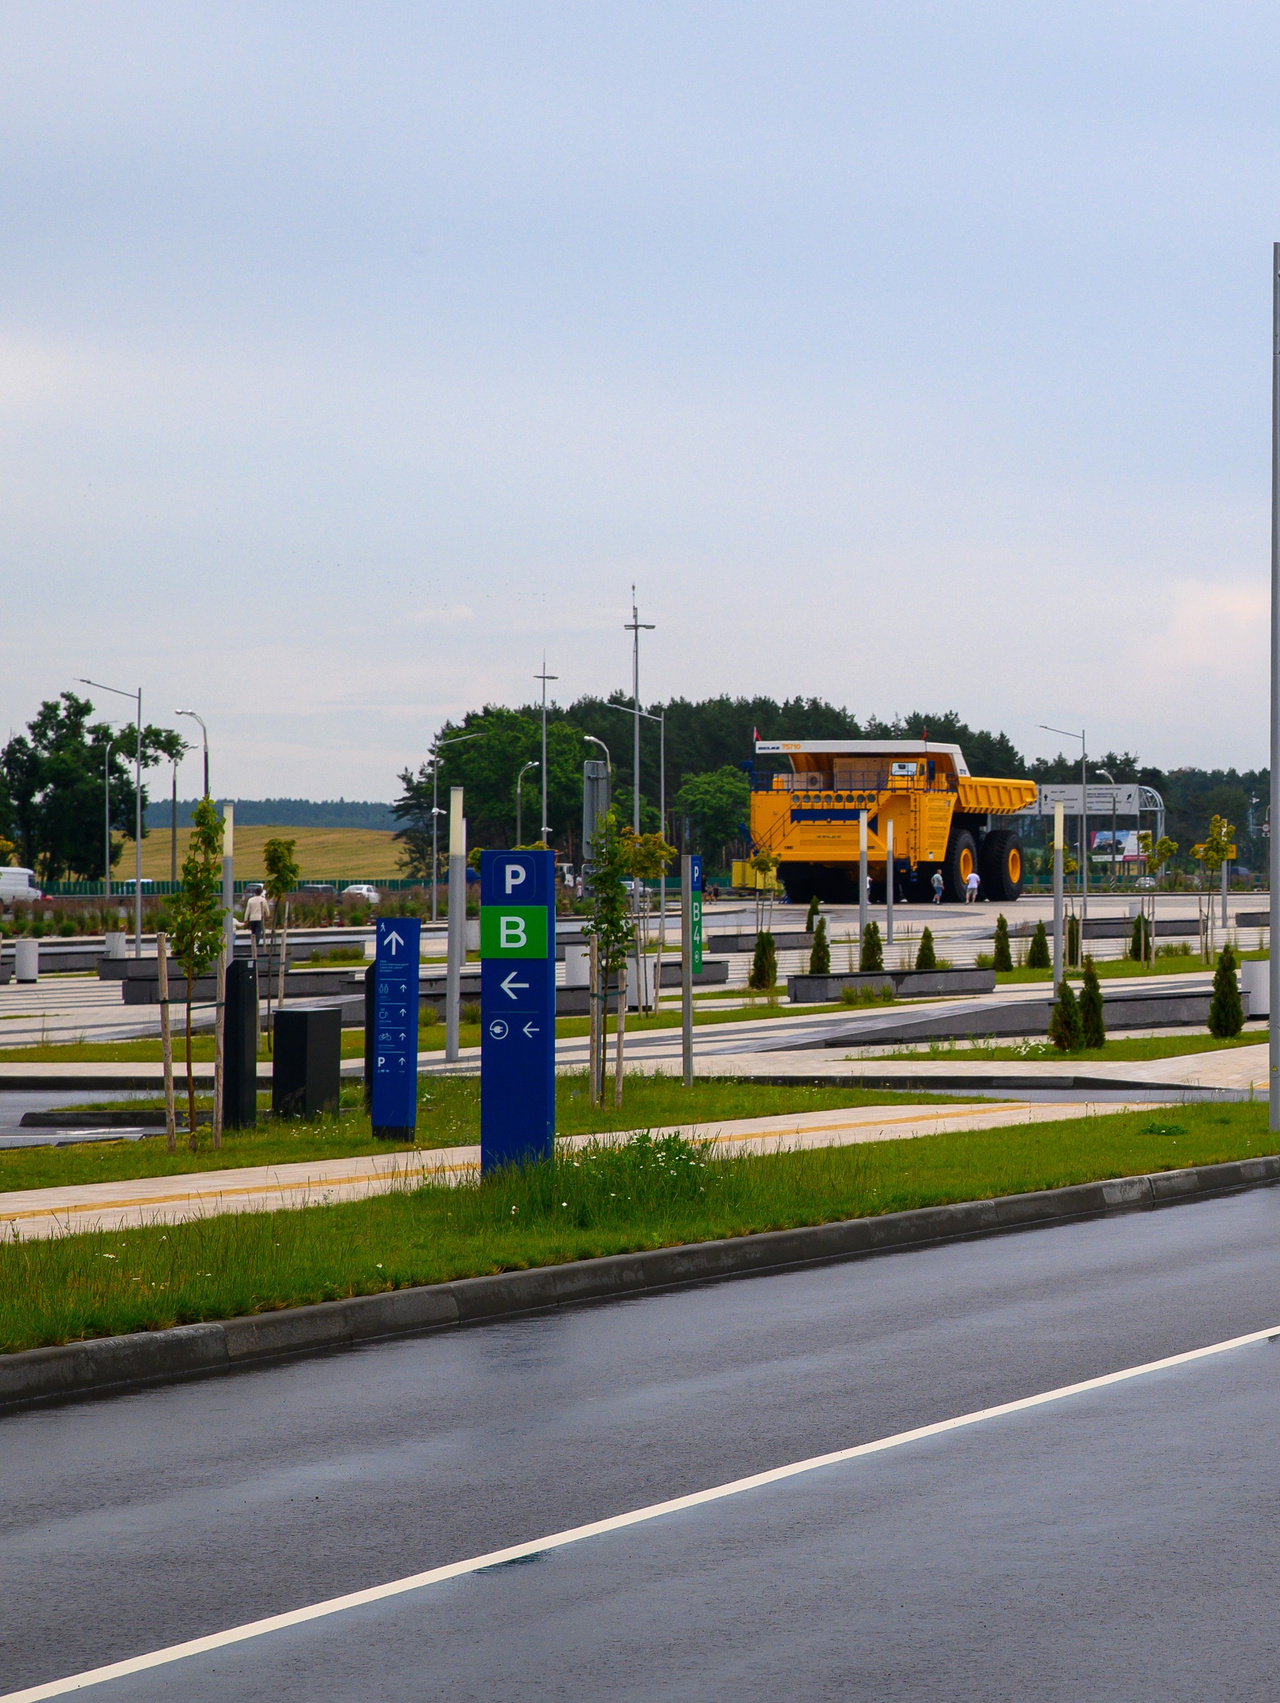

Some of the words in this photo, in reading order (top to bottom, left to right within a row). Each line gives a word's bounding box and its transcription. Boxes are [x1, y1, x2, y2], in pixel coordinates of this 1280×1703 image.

[505, 864, 526, 894] P
[694, 866, 699, 882] P
[693, 902, 700, 921] B
[500, 916, 527, 948] B
[694, 925, 700, 944] 4
[378, 1057, 385, 1067] P
